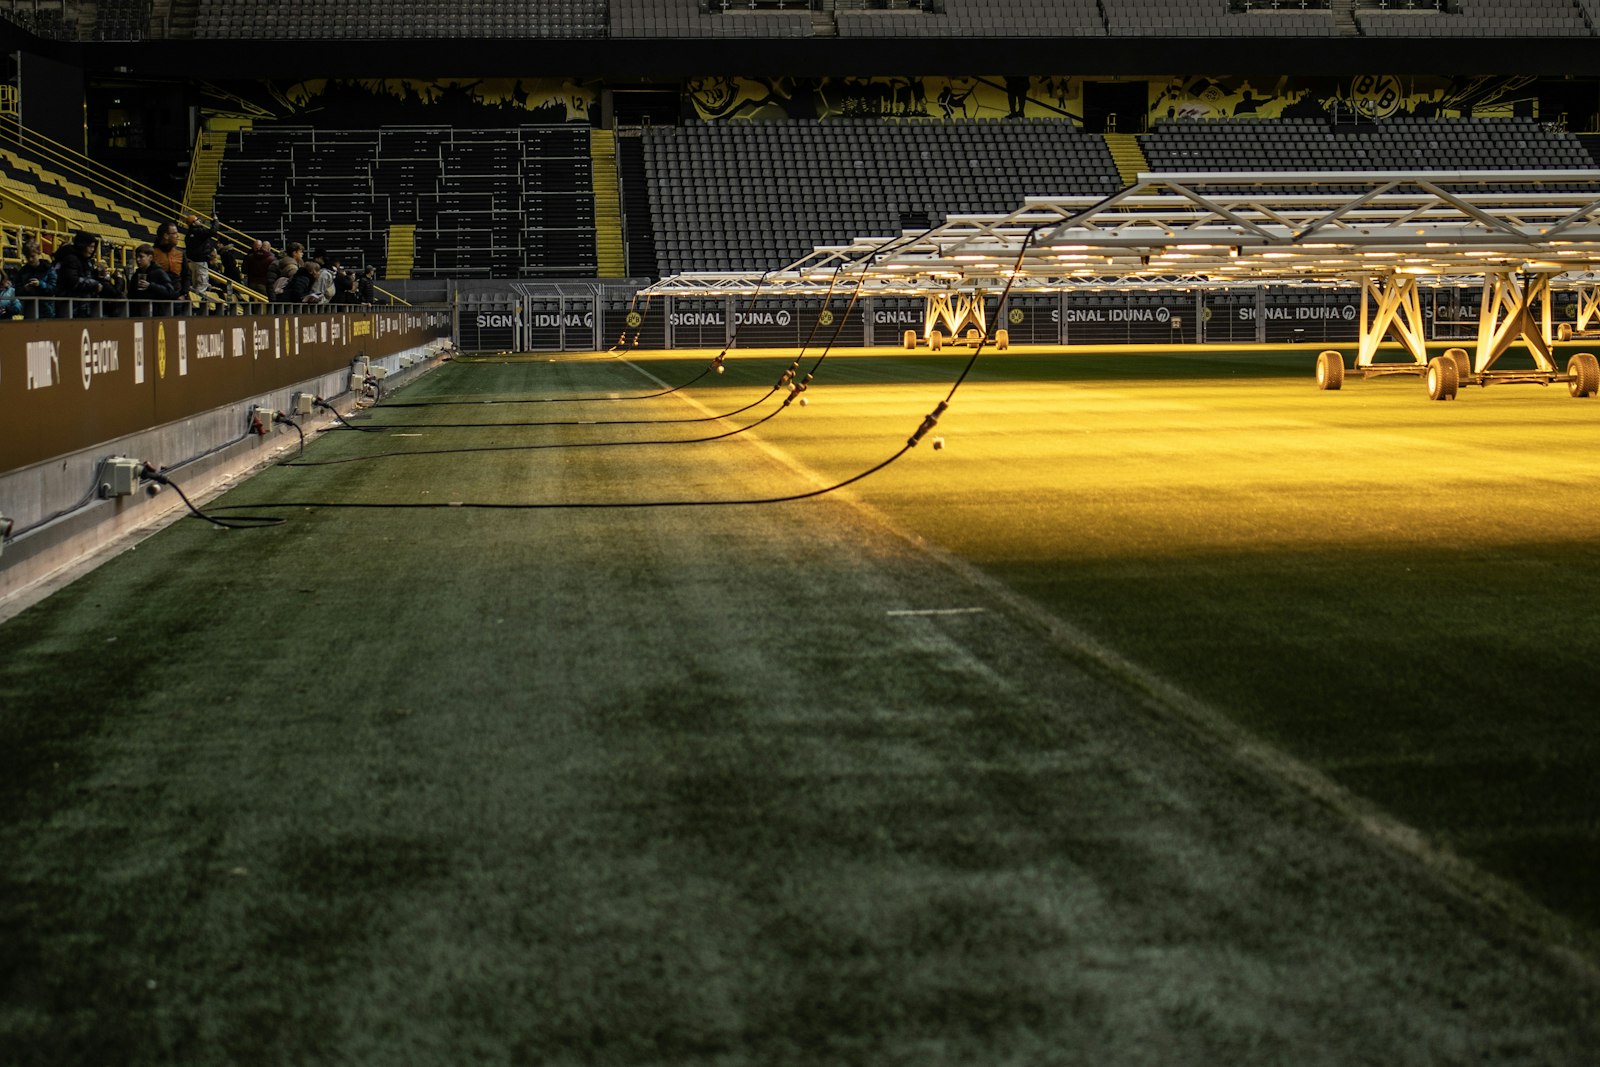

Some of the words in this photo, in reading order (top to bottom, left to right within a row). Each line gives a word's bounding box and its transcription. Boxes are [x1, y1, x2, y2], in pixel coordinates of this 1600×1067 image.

[1356, 74, 1396, 109] BVB
[571, 96, 585, 111] 12
[628, 314, 641, 324] BVB
[670, 312, 725, 326] SIGNAL
[734, 312, 774, 325] DUNA
[1052, 309, 1105, 322] SGNAL
[1109, 308, 1154, 321] IDUNA
[1296, 307, 1340, 320] IDUNA
[1425, 305, 1477, 319] SGAL
[535, 314, 582, 327] IDUNA
